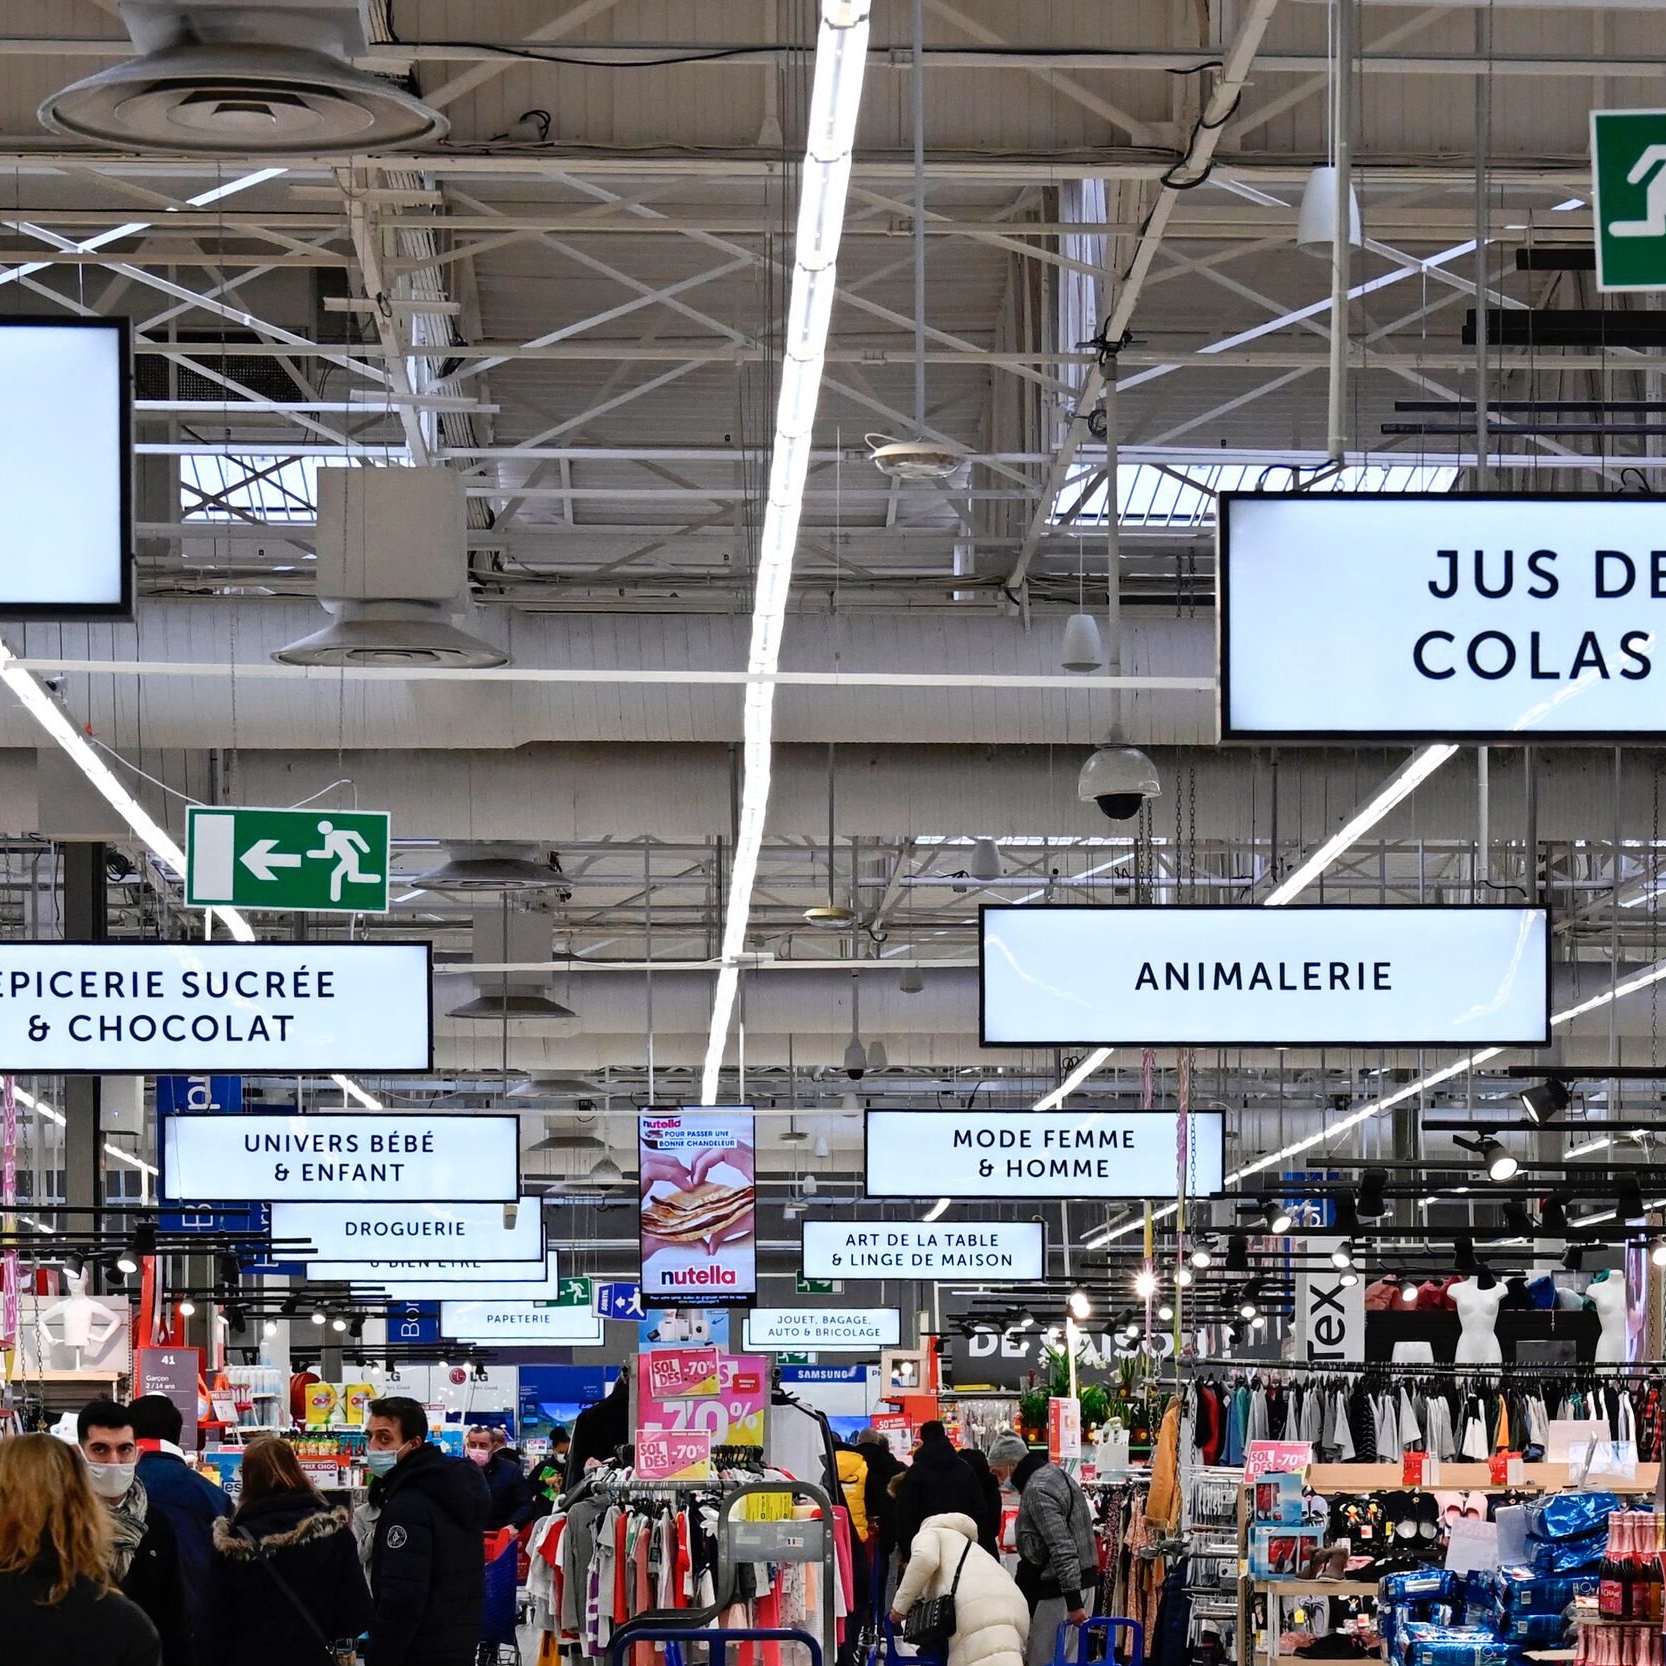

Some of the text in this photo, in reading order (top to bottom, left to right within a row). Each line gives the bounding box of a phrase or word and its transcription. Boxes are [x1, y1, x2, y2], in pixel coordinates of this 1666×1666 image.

[1428, 550, 1558, 599] JUS
[1413, 631, 1651, 680] COLAS
[182, 965, 334, 998] SUCRÉE
[1135, 962, 1391, 990] ANIMALERIE
[29, 1015, 294, 1041] & CHOCOLAT
[643, 1119, 681, 1129] nutella
[245, 1131, 433, 1152] UNIVERS BÉBÉ
[954, 1130, 1134, 1148] MODE FEMME
[275, 1163, 404, 1181] & ENFANT
[979, 1159, 1108, 1177] & HOMME
[346, 1222, 464, 1236] DROGUERIE
[846, 1234, 998, 1246] ART DE LA TABLE
[832, 1254, 1011, 1266] & LINGE DE MAISON
[661, 1266, 736, 1285] nutella
[487, 1315, 549, 1323] PAPETERIE
[777, 1316, 871, 1326] JOUET, BAGAGE,
[1307, 1284, 1346, 1361] Tex
[768, 1328, 881, 1337] AUTO & BRICOLAGE
[161, 1355, 176, 1365] 41
[655, 1361, 676, 1374] SOL
[683, 1360, 715, 1376] -70%
[145, 1375, 169, 1383] Garçon
[470, 1372, 489, 1382] LG
[660, 1372, 682, 1386] DES
[797, 1370, 848, 1380] SAMSUNG
[640, 1443, 661, 1455] SOL
[672, 1445, 705, 1459] -70%
[1249, 1450, 1273, 1462] SOL
[645, 1455, 667, 1467] DES
[1275, 1453, 1306, 1467] -70%
